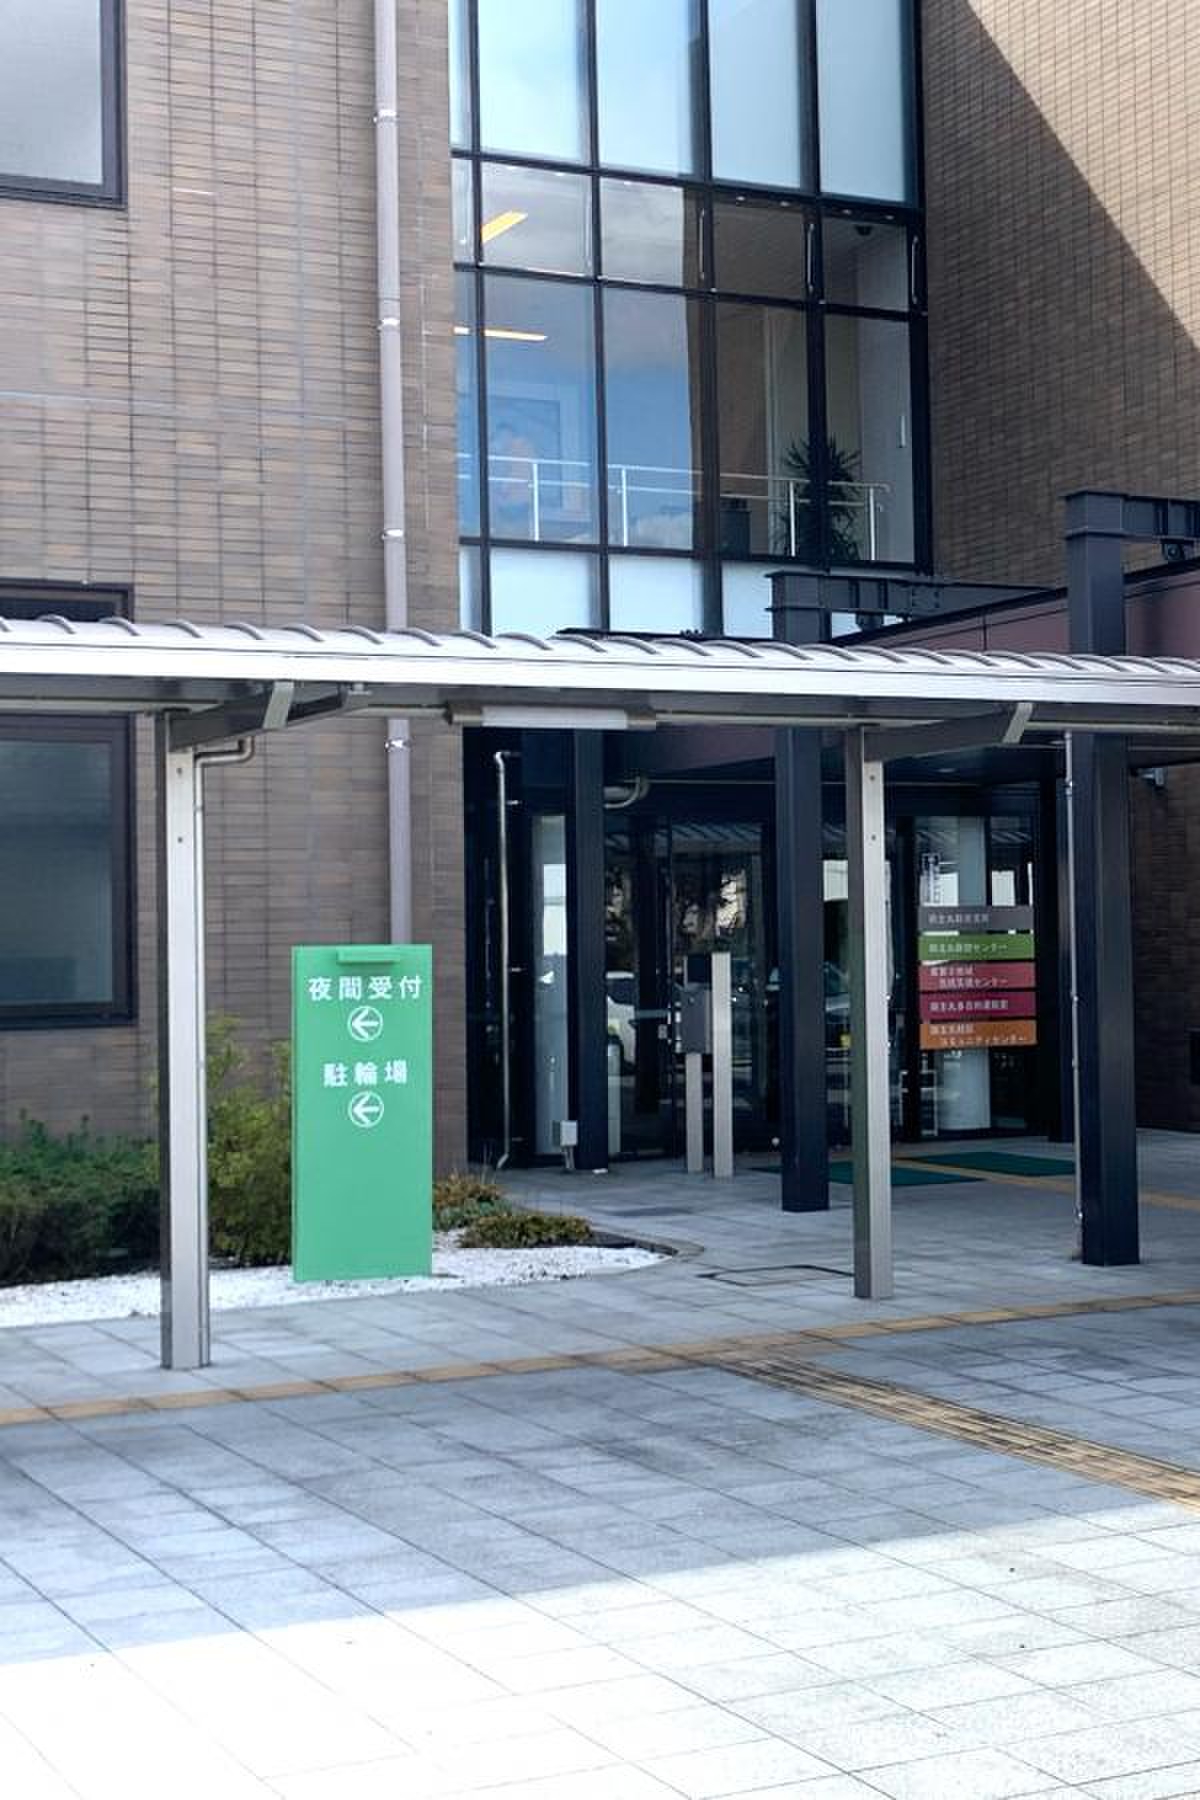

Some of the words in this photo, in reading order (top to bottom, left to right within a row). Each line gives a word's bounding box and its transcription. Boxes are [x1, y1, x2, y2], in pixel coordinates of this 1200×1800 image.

[308, 974, 422, 1001] 夜間受付
[323, 1060, 407, 1087] 駐輪場
